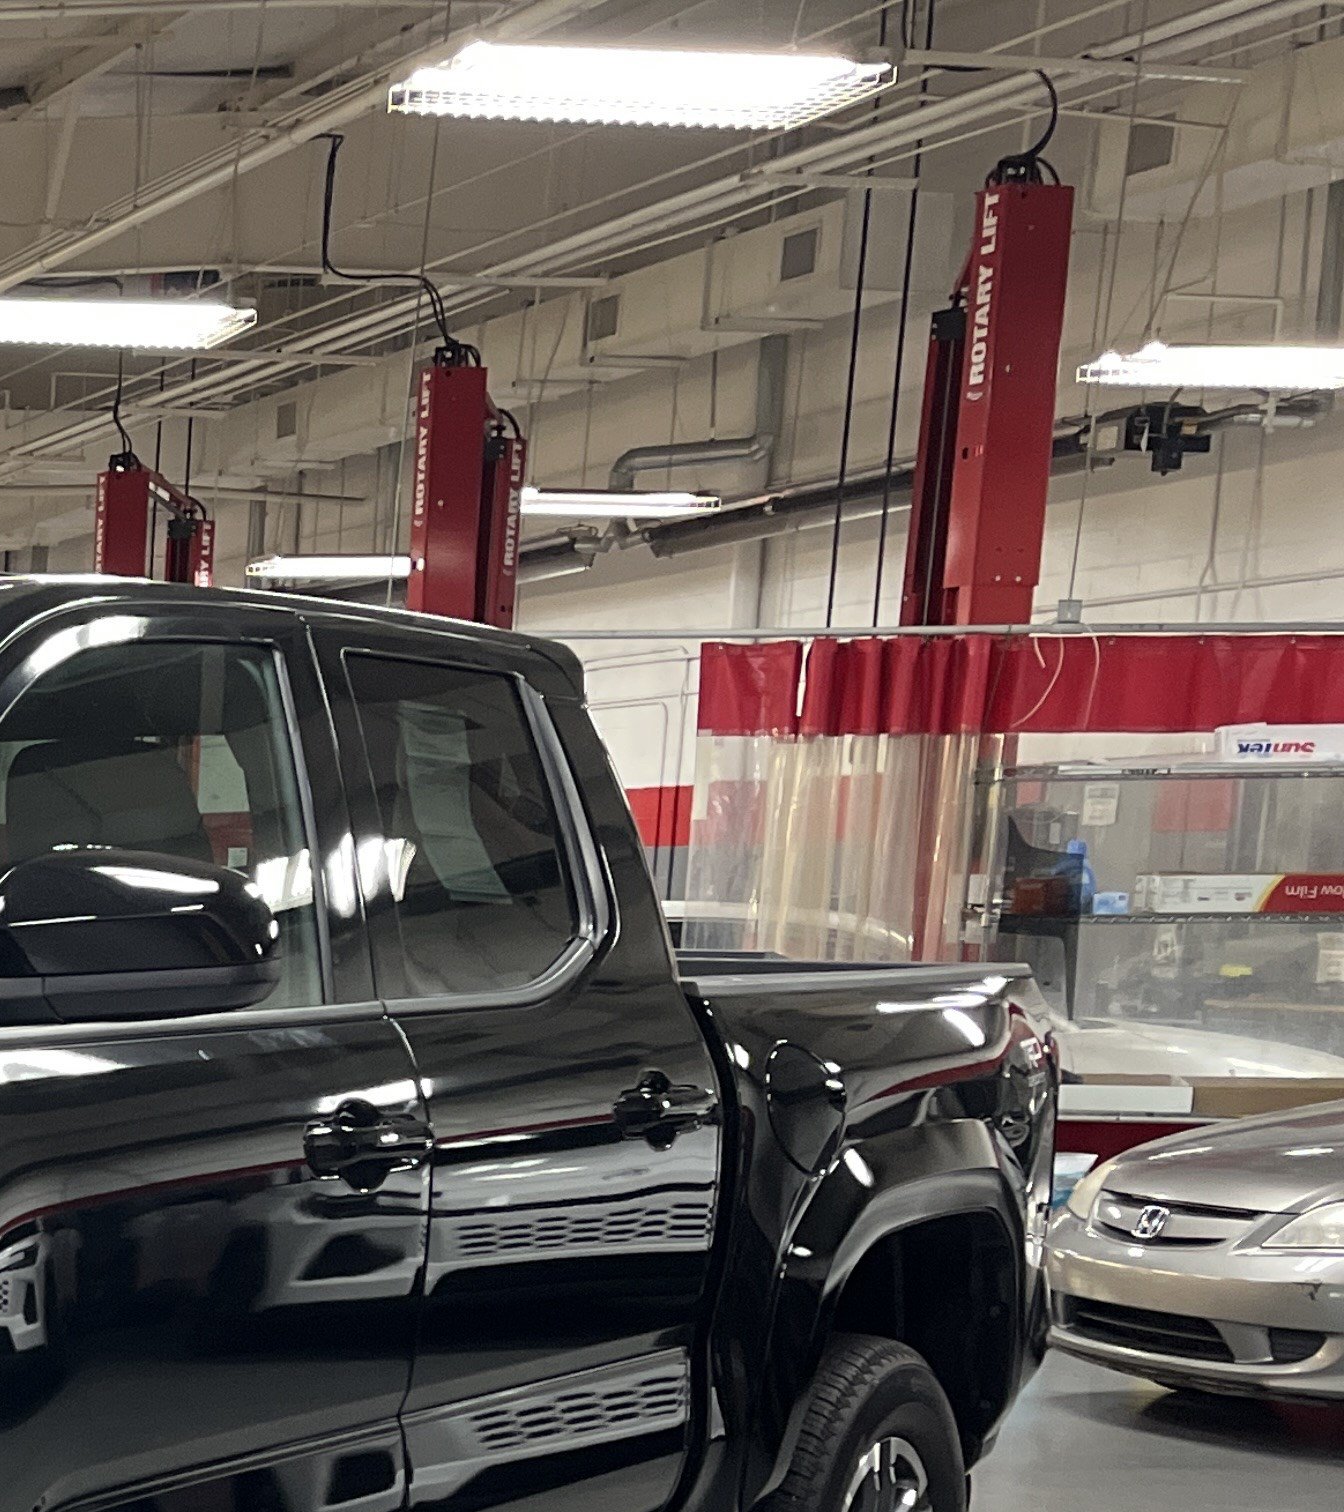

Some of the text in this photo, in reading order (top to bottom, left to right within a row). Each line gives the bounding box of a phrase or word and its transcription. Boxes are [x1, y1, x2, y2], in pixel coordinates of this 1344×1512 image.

[968, 192, 1000, 386] ROTARY LIFT
[414, 372, 432, 516] ROTARY LIFT
[503, 442, 523, 566] ROTARY LIFT
[201, 522, 211, 555] LIFT
[1285, 885, 1344, 899] ow Film
